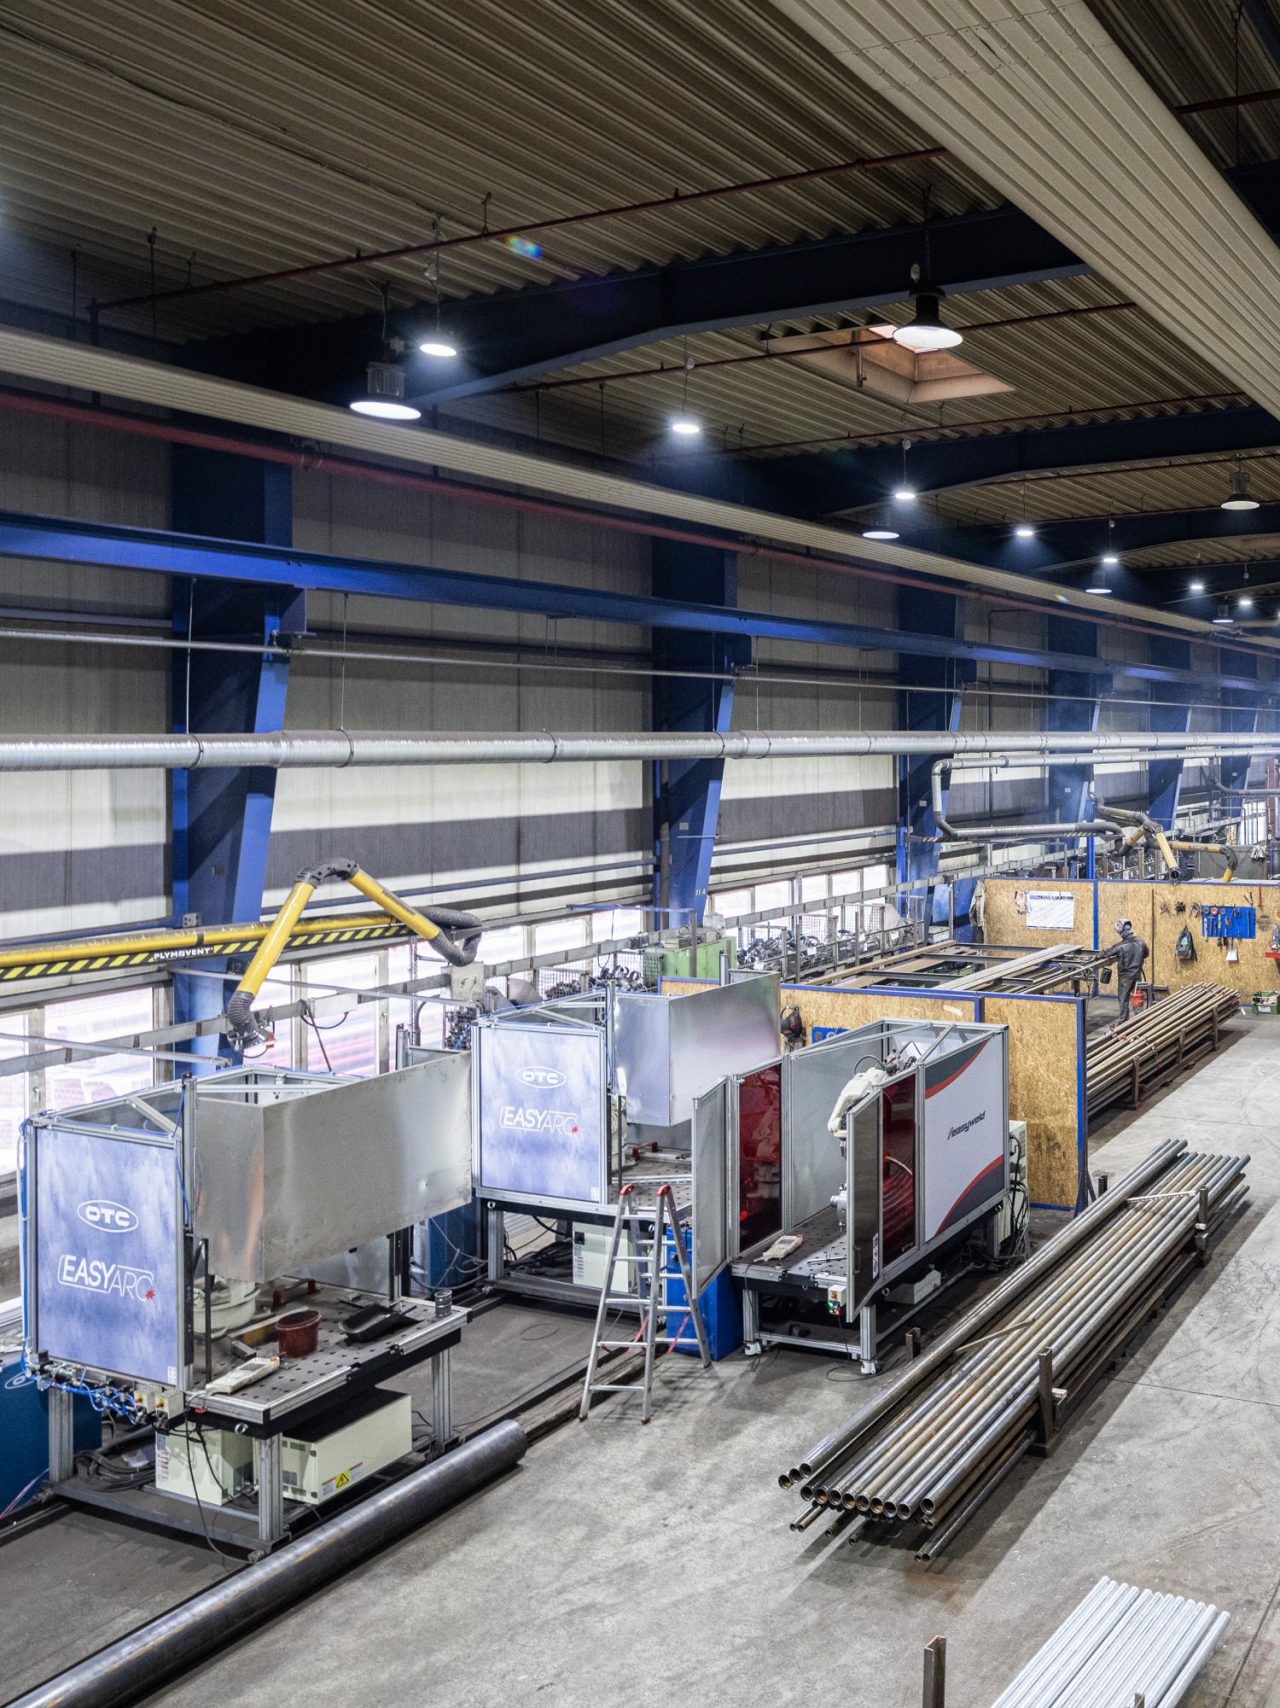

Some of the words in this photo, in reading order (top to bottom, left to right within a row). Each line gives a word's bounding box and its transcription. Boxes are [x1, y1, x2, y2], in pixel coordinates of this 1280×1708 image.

[154, 948, 211, 960] PLYMOVENT
[522, 1070, 559, 1084] OTC
[85, 1205, 130, 1227] OTC
